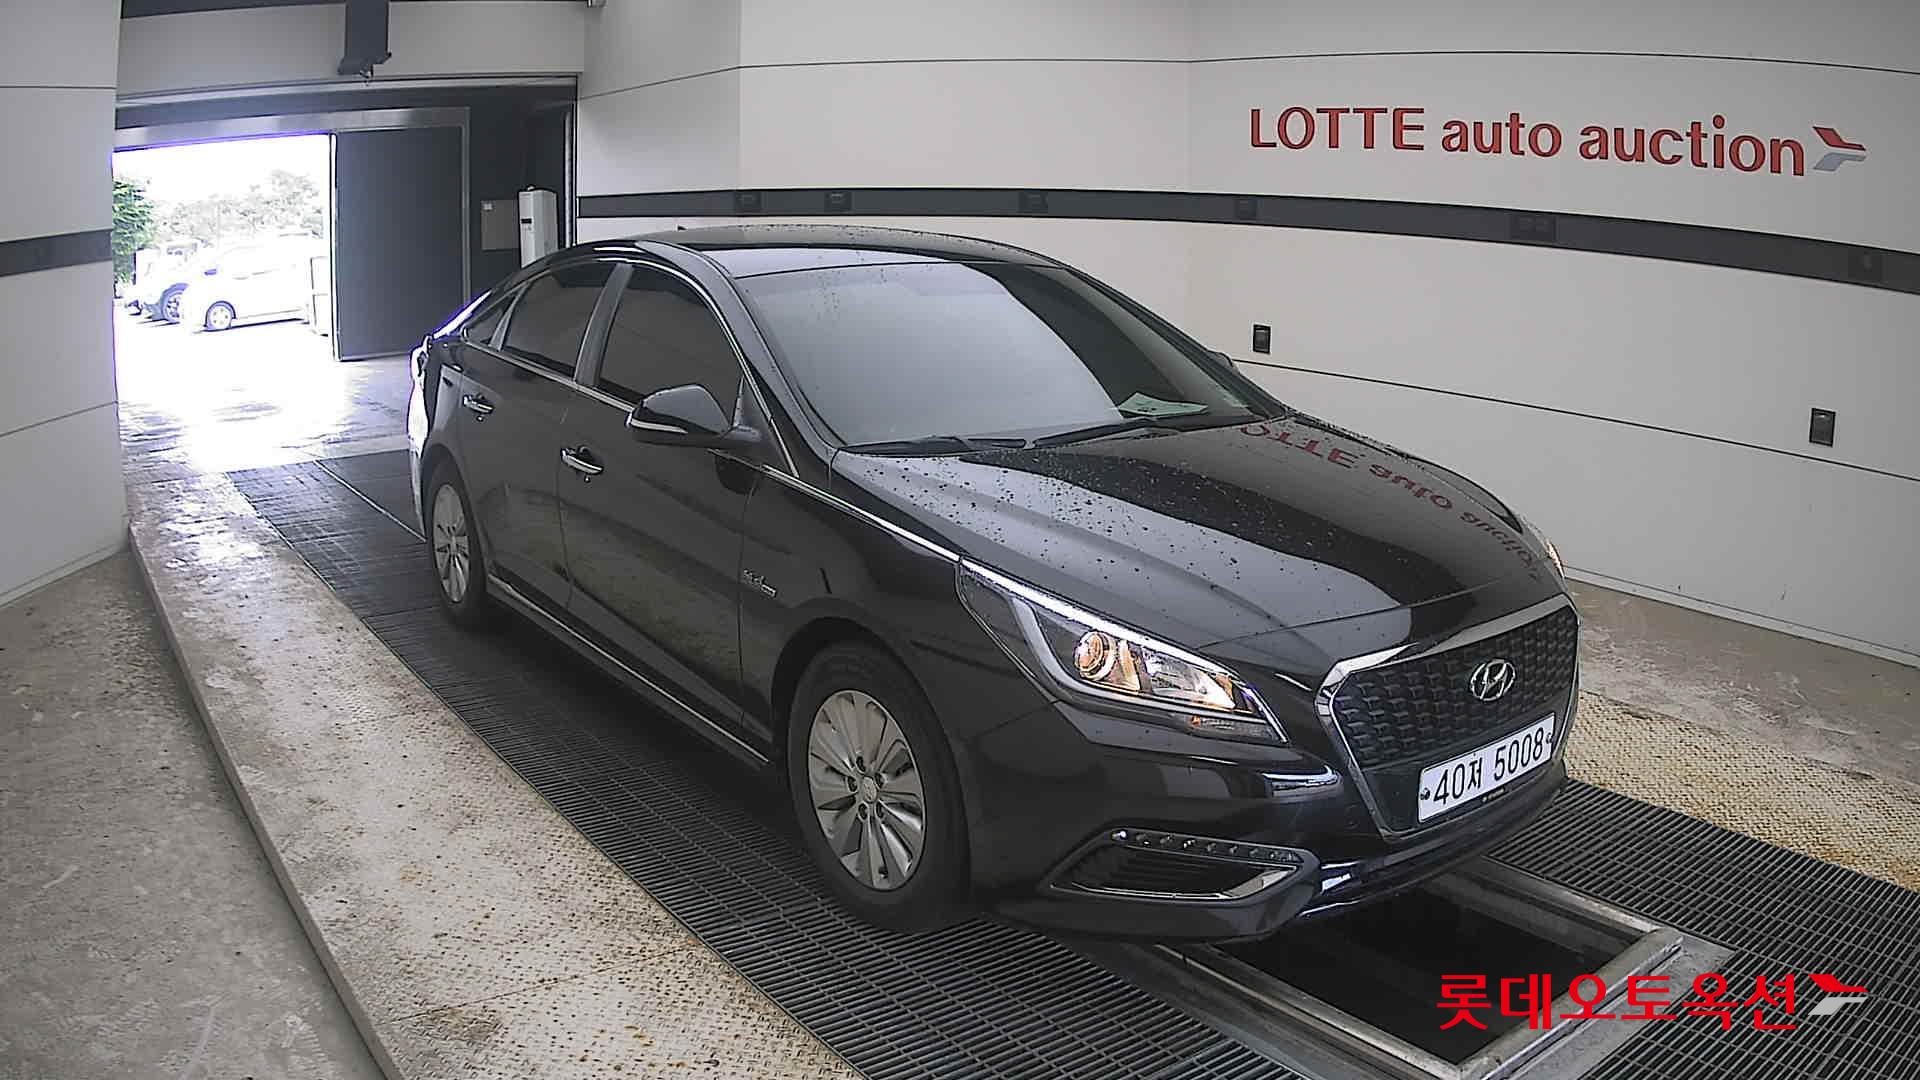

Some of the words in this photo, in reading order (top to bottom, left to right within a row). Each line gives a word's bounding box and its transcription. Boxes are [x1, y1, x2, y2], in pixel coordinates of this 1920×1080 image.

[1250, 106, 1425, 151] LOTTE
[1441, 112, 1562, 158] auto
[1579, 114, 1805, 177] auction
[1433, 757, 1482, 804] 40저
[1494, 727, 1544, 782] 5008
